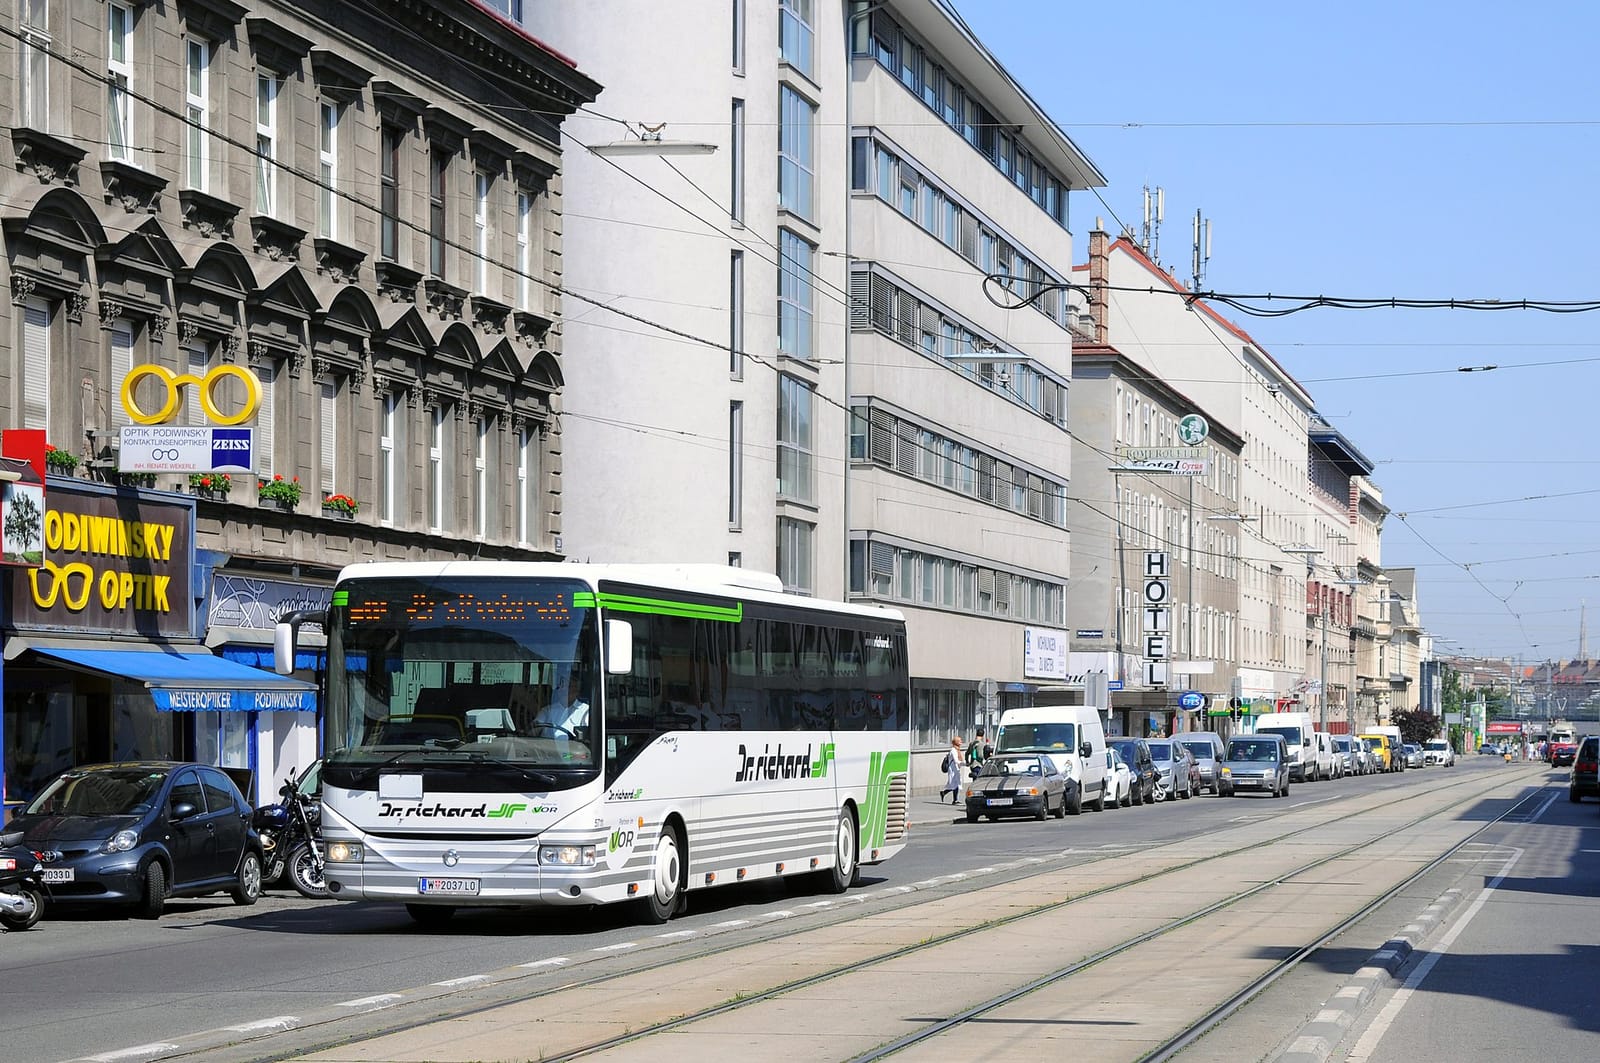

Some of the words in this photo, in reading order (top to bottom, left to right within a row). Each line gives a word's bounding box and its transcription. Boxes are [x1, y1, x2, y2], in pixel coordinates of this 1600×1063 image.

[124, 429, 150, 438] OPTIK
[153, 429, 208, 438] PODIWINSKY
[123, 439, 208, 447] KONTAKTLINSENOPTIKER
[212, 439, 250, 450] ZEISS
[45, 509, 175, 561] ODIWINSKY
[100, 569, 171, 612] OPTIK
[1146, 553, 1166, 686] HOTEL
[169, 692, 232, 708] MEISTEROPTIKER
[254, 692, 303, 708] PODIWINSKY
[1182, 697, 1201, 706] EFES
[610, 827, 634, 850] VOR
[440, 880, 463, 891] 2037
